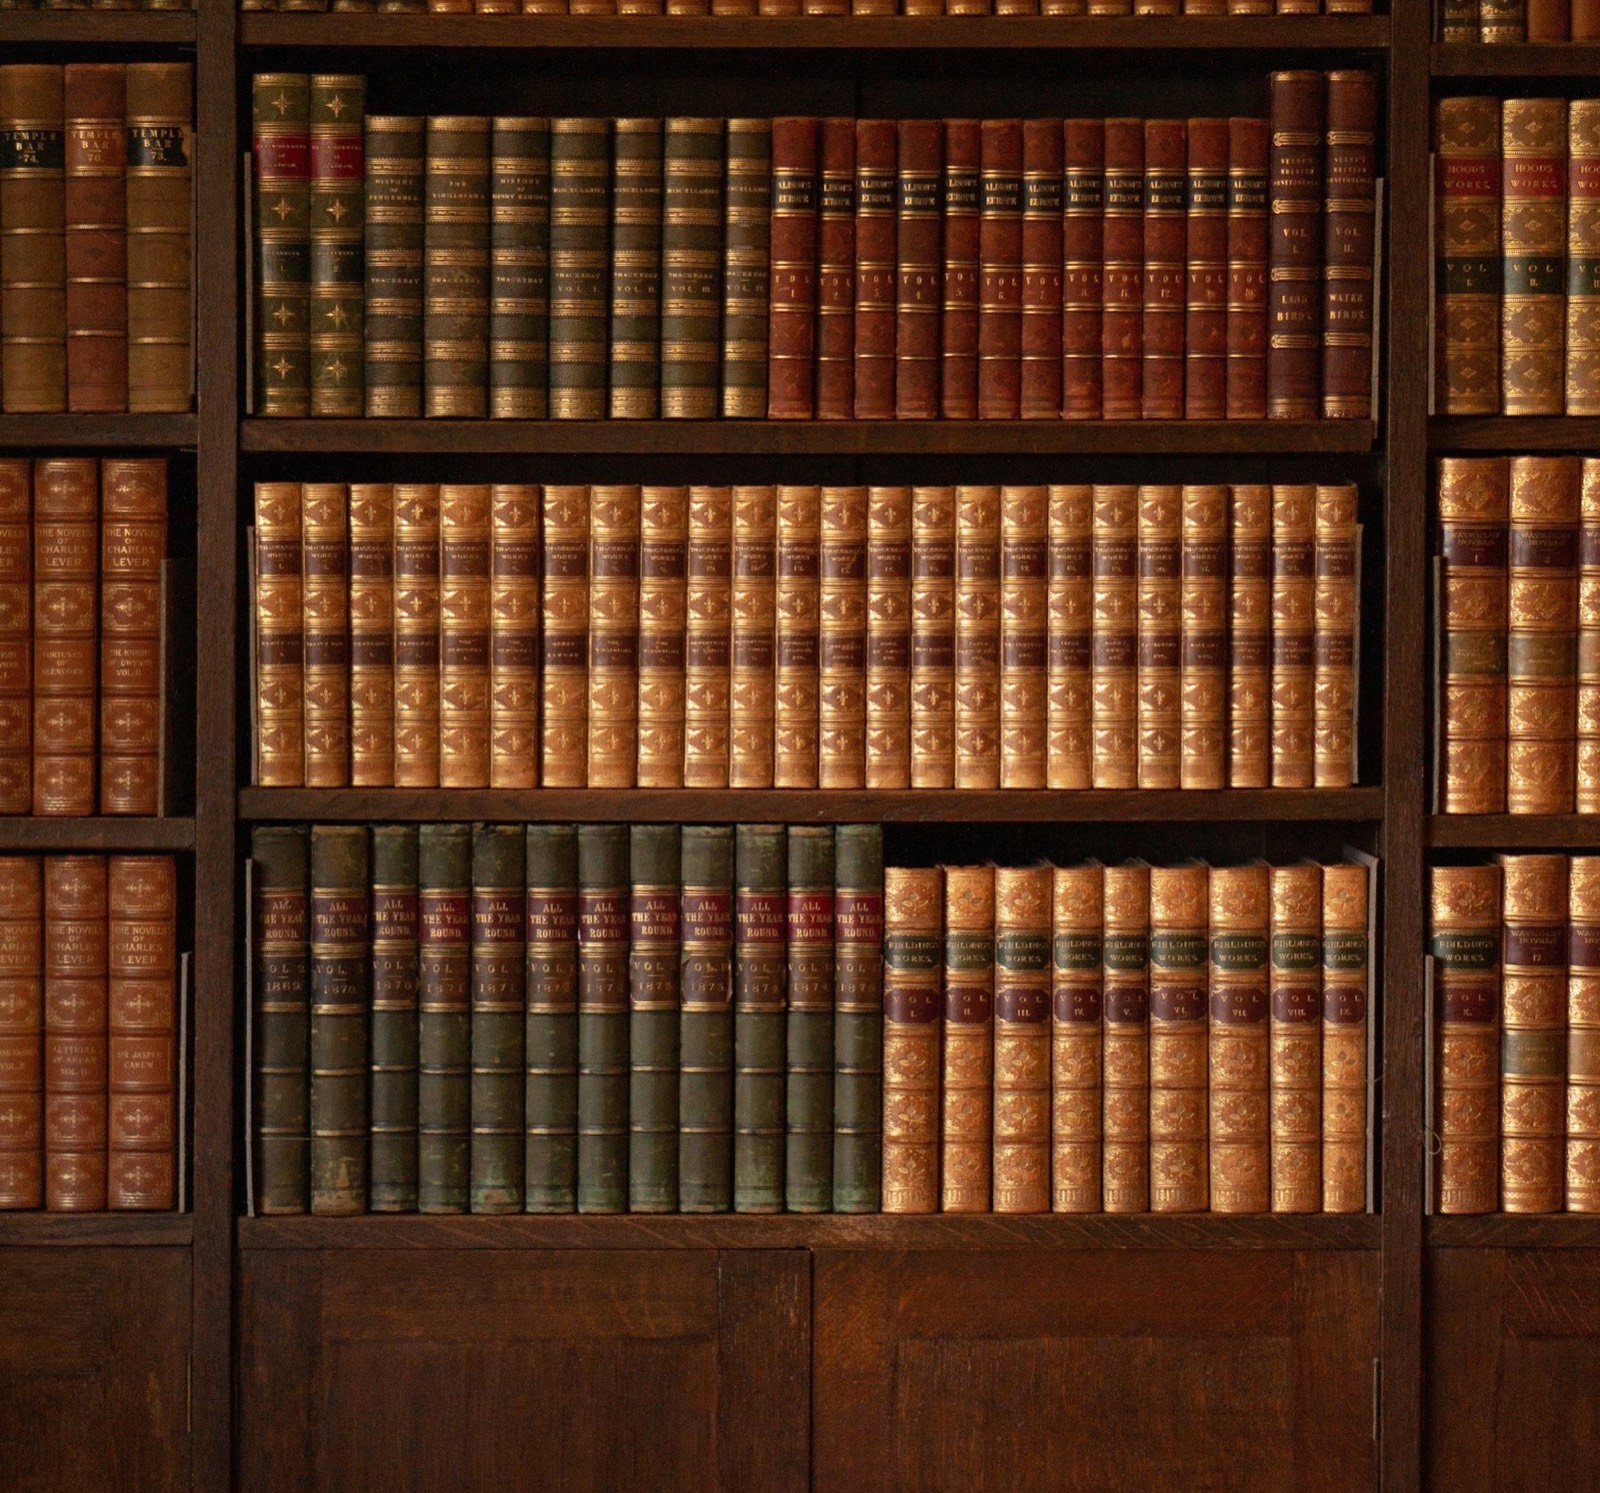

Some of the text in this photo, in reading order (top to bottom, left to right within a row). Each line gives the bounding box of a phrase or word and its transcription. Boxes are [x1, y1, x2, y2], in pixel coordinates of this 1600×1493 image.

[82, 141, 108, 149] BAR
[144, 139, 171, 148] BAR
[45, 558, 82, 566] LEVER
[113, 558, 150, 566] LEVER
[329, 902, 348, 911] ALL
[384, 900, 403, 909] ALL
[436, 903, 455, 912] ALL
[489, 902, 508, 911] ALL
[543, 904, 562, 912] ALL
[595, 903, 613, 912] ALL
[646, 901, 665, 910] ALL
[698, 902, 717, 910] ALL
[752, 902, 770, 911] ALL
[802, 902, 820, 910] ALL
[850, 903, 868, 912] ALL
[317, 915, 335, 923] THE
[424, 916, 441, 924] THE
[476, 914, 493, 922] THE
[531, 915, 547, 924] THE
[582, 915, 599, 924] THE
[632, 913, 649, 921] THE
[686, 913, 703, 922] THE
[738, 914, 755, 922] THE
[837, 914, 854, 923] THE
[116, 943, 163, 951] CHARLES
[57, 955, 94, 964] LEVER
[121, 955, 157, 964] LEVER
